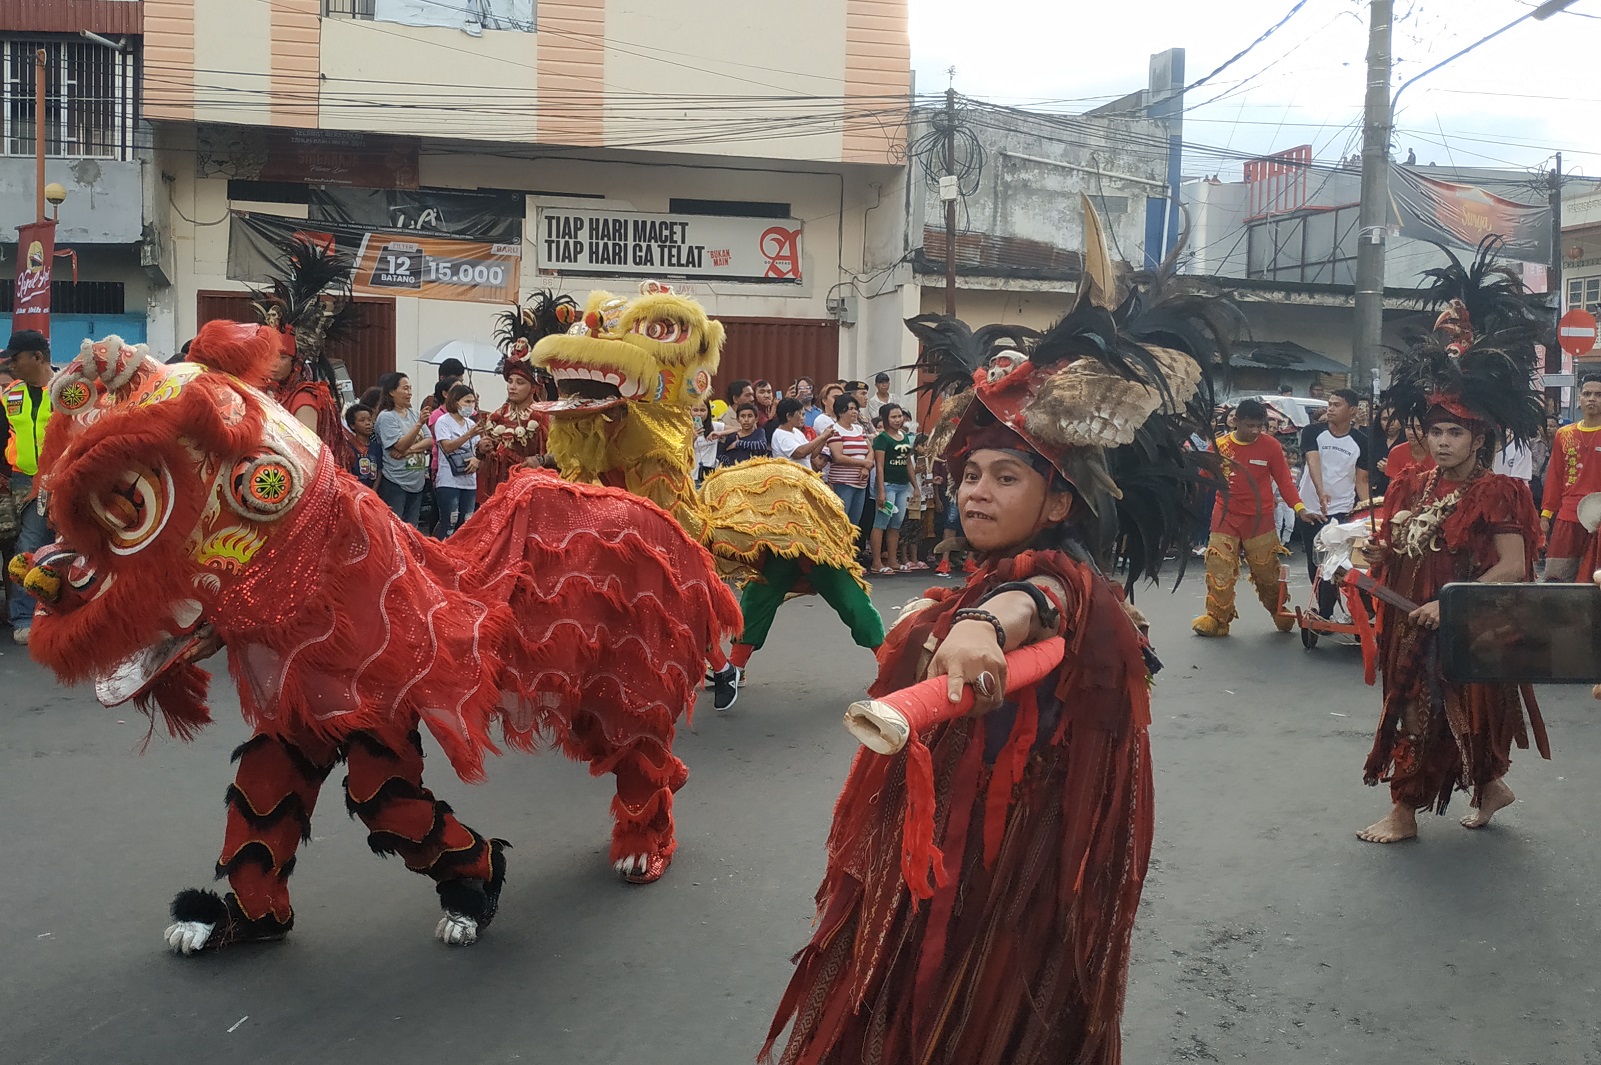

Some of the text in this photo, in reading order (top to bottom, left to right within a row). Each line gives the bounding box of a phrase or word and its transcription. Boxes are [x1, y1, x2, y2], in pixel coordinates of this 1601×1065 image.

[544, 215, 689, 244] TIAP HARI MACET
[496, 245, 518, 254] BARU
[544, 239, 705, 268] TIAP HARI GA TELAT
[387, 255, 411, 275] 12
[429, 261, 503, 285] 15.000
[381, 273, 416, 284] BATANG
